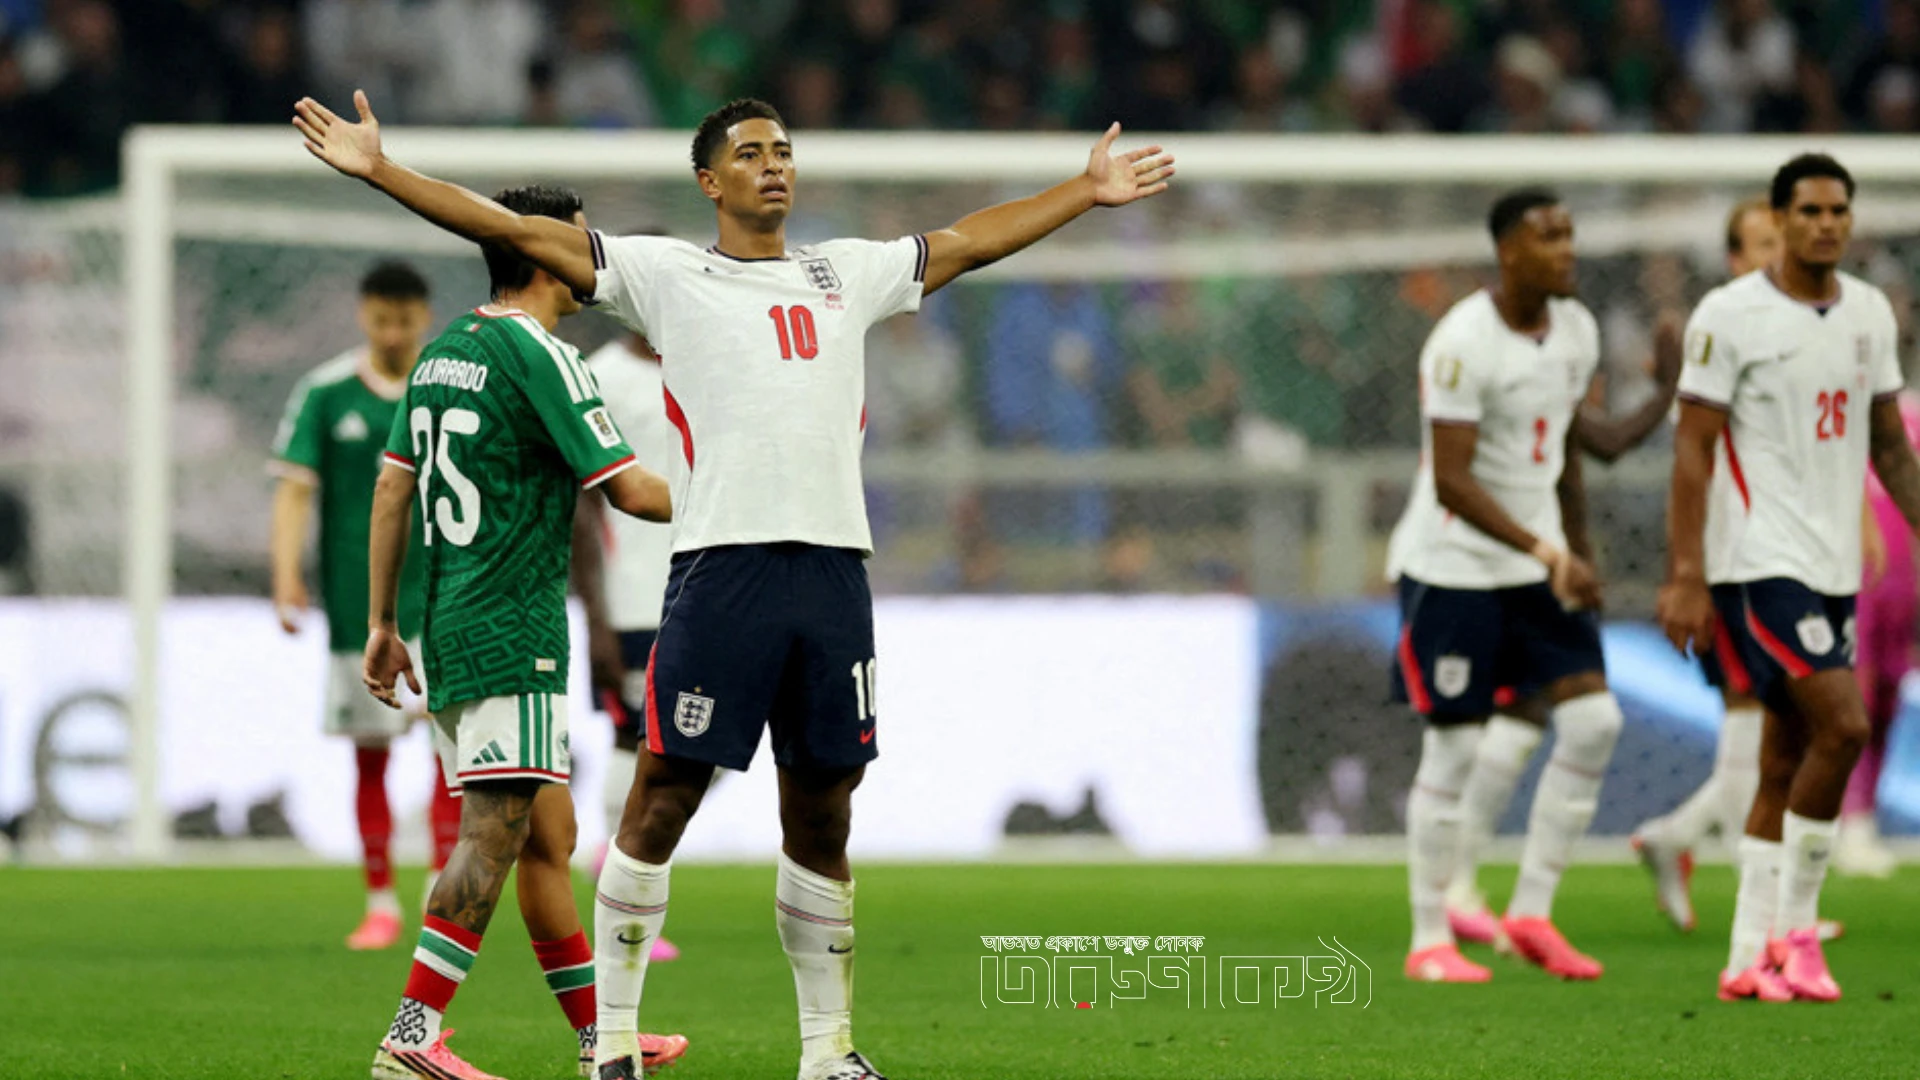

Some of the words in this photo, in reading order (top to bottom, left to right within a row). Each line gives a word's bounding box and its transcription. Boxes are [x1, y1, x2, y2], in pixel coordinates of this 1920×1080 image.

[768, 305, 818, 361] 10
[1531, 417, 1548, 465] 2
[1816, 389, 1848, 441] 26
[410, 406, 481, 547] 25
